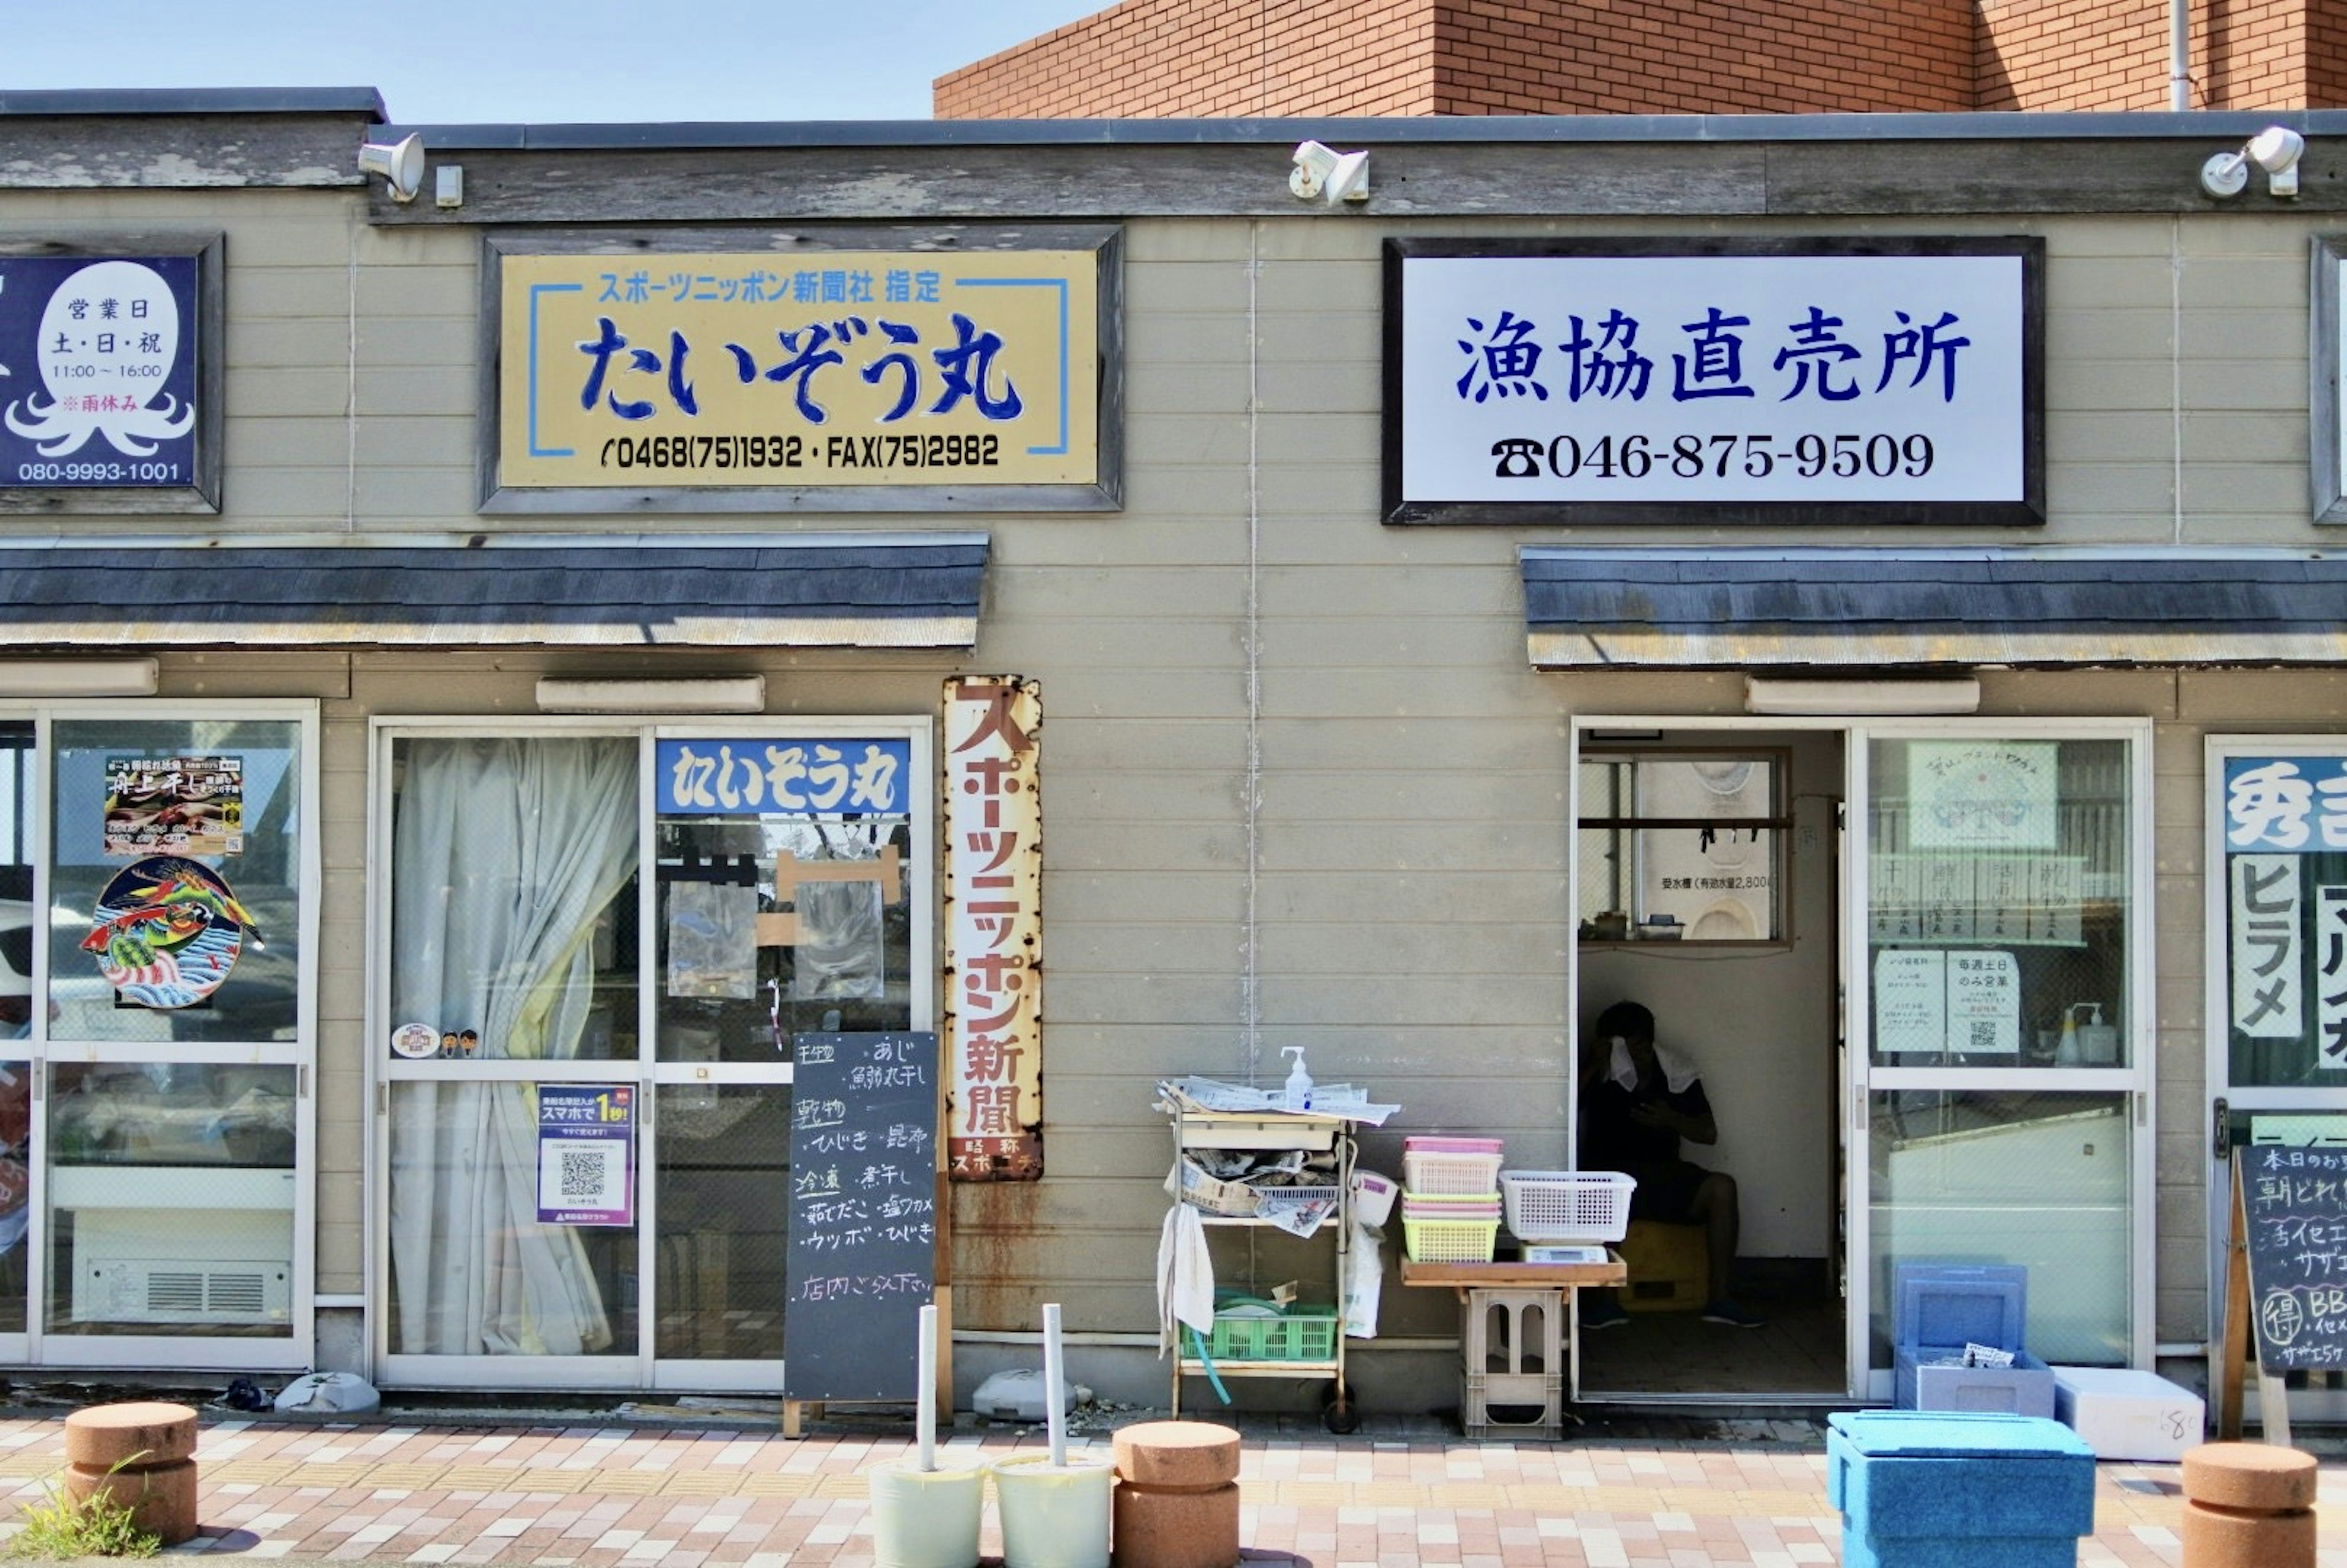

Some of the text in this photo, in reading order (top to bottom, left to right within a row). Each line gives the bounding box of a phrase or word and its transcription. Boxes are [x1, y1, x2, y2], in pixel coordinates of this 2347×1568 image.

[598, 270, 941, 302] スポーツニッポン新聞社 指定
[68, 298, 149, 320] 営業日
[51, 332, 162, 354] 土・日・祝
[1457, 306, 1971, 403] 漁協直売所
[575, 311, 1024, 424] たいぞう丸
[1548, 434, 1935, 480] 046-875-9509
[18, 463, 179, 481] 080-9993-1001
[673, 744, 898, 810] たいぞう丸
[951, 685, 1034, 1134] スポーツニッポン新聞
[2242, 862, 2294, 1027] ヒラメ
[1959, 959, 2007, 971] 毎週土日
[1959, 976, 2009, 987] のみ営業
[873, 1040, 915, 1061] あじ
[886, 1124, 928, 1154] 昆布
[964, 1138, 1020, 1154] 略称
[796, 1166, 912, 1193] 冷凍 煮干し
[808, 1226, 872, 1250] ウツボ
